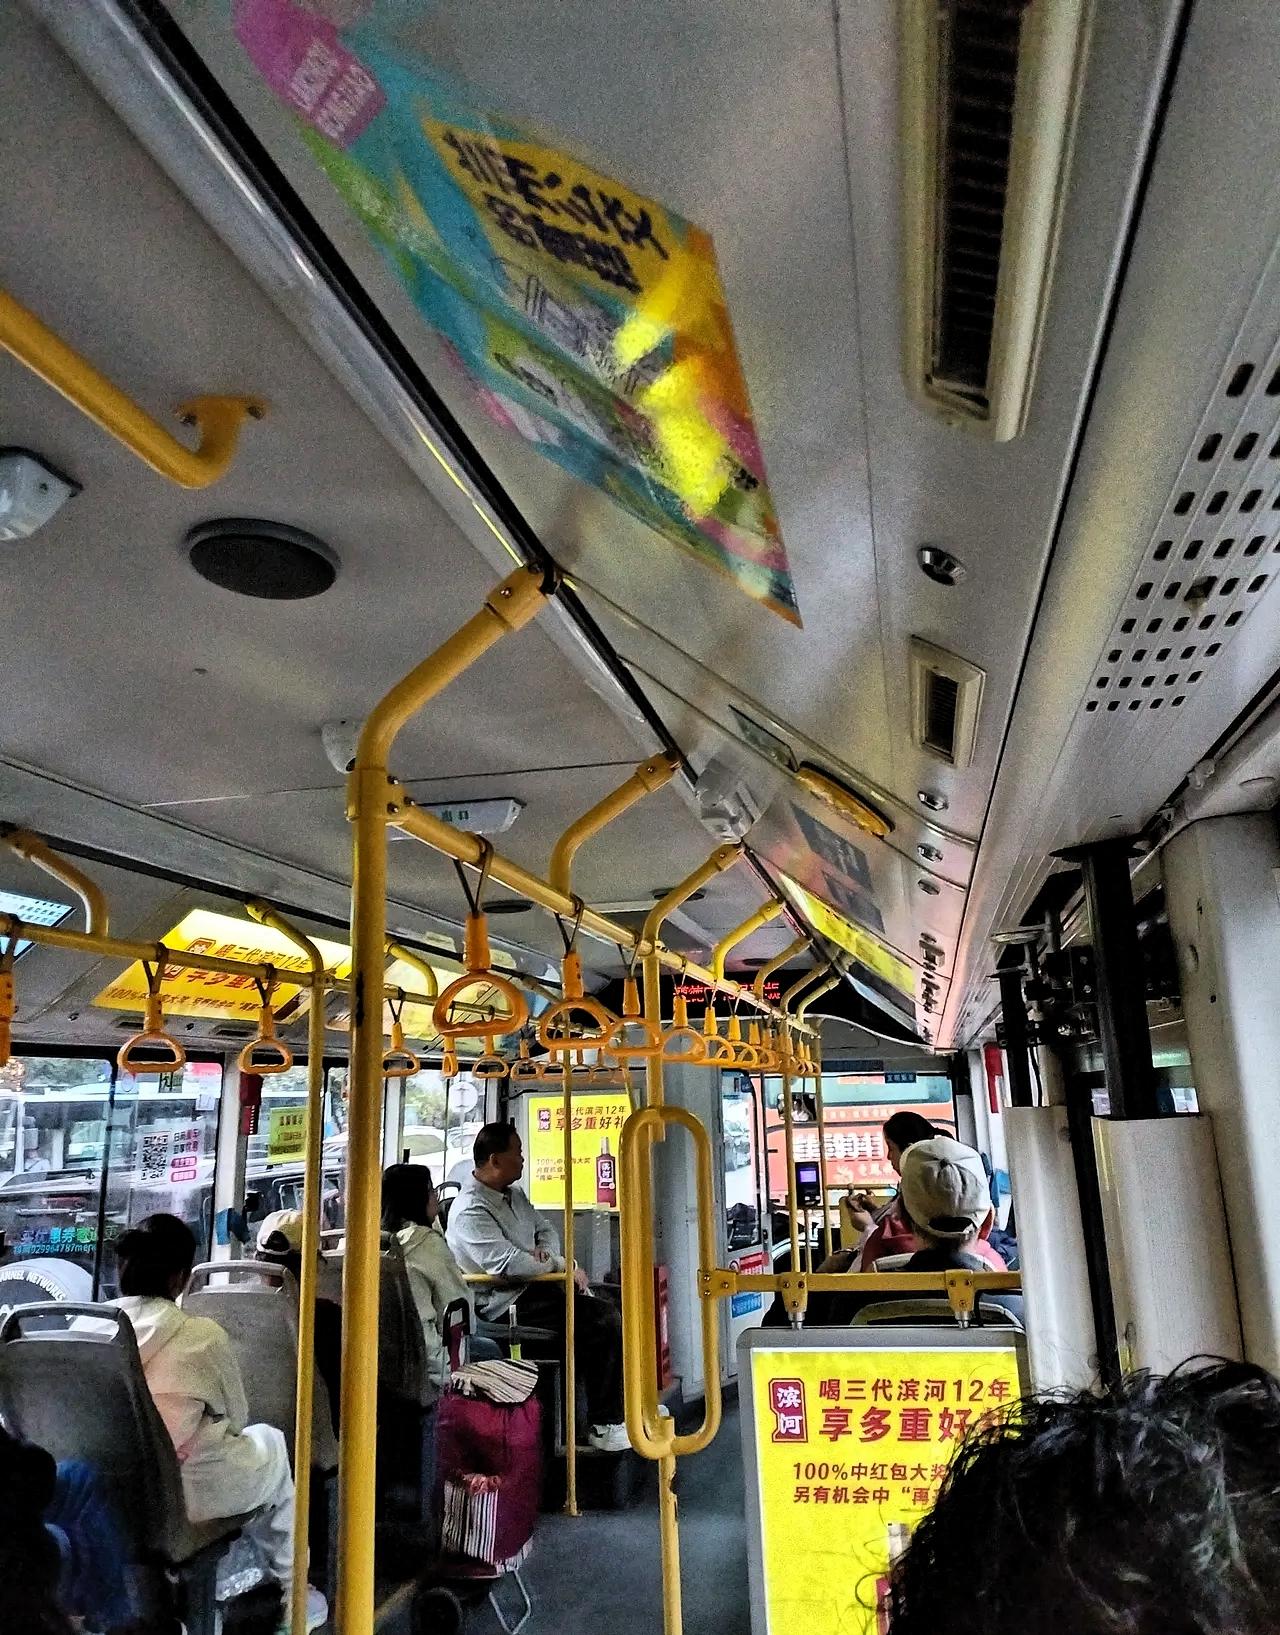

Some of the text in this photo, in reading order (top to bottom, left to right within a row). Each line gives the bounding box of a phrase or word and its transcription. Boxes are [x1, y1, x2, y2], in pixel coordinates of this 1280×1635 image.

[26, 1271, 66, 1301] NETWORKS
[819, 1378, 1012, 1403] 喝三代滨河12年
[777, 1386, 804, 1435] 滨河
[793, 1462, 949, 1482] 100%中红包大奖
[793, 1486, 938, 1506] 另有机会中“再
